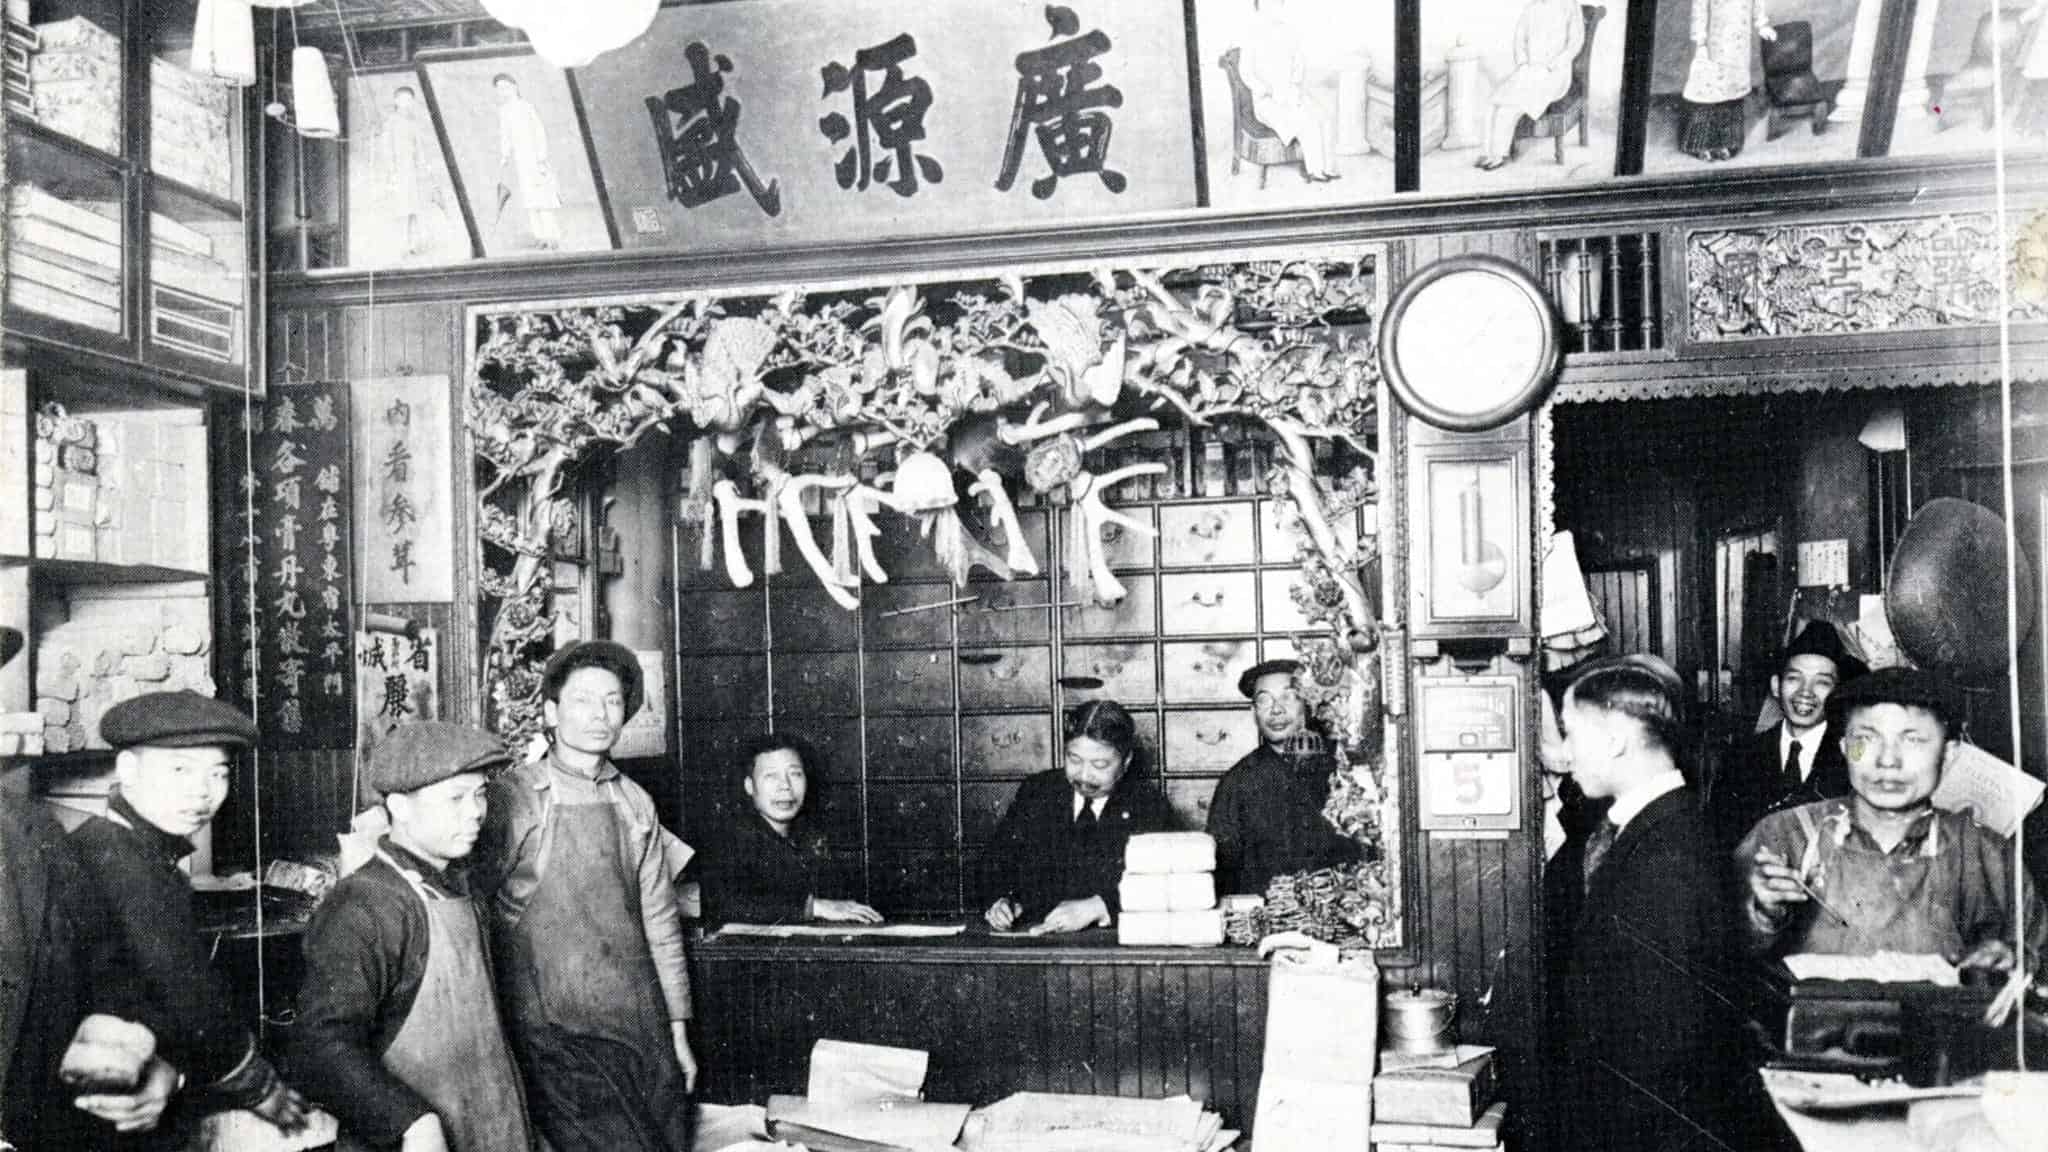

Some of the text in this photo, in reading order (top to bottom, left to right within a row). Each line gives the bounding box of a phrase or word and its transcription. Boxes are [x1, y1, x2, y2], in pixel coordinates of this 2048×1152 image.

[645, 5, 1127, 217] 廣源盛
[1453, 761, 1485, 804] 5
